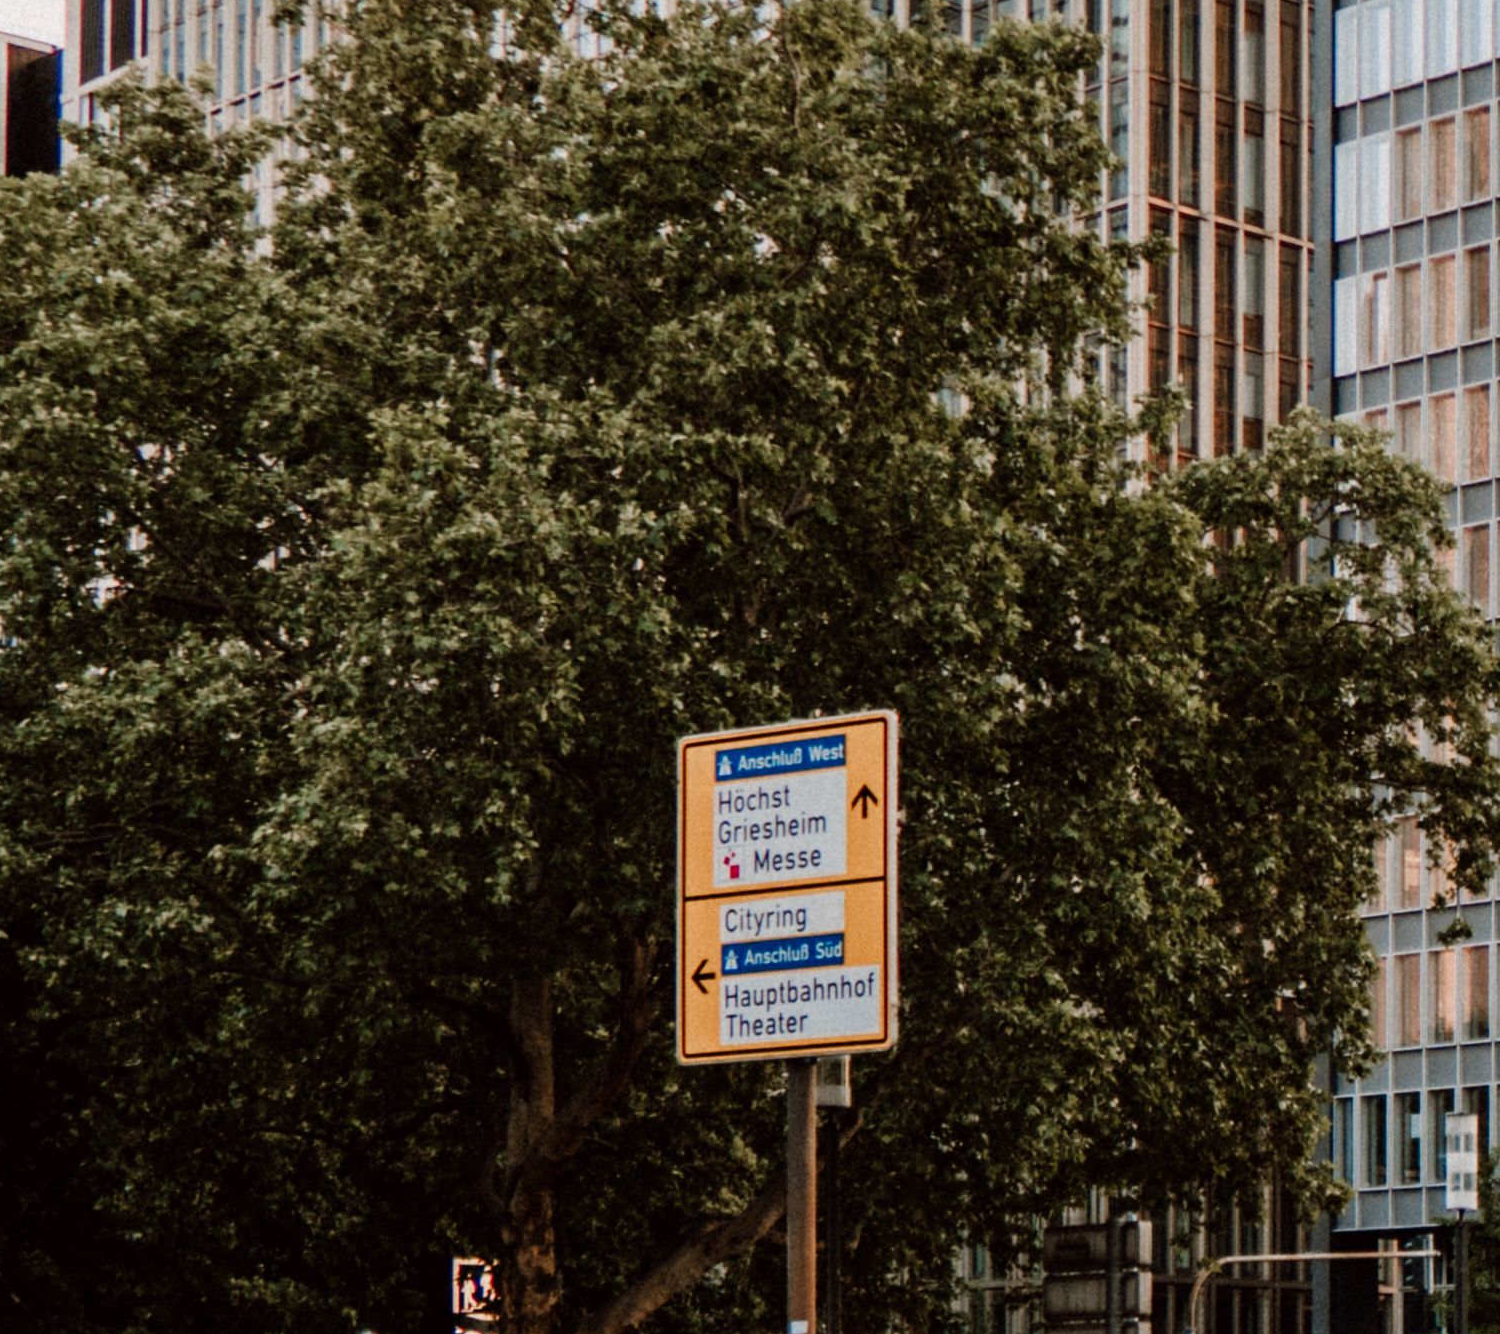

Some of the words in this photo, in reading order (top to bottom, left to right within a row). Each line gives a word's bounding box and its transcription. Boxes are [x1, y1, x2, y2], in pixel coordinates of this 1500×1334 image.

[738, 747, 802, 771] Anschluß
[809, 743, 844, 762] West
[718, 785, 790, 814] Höchst
[719, 811, 826, 844] Griesheim
[754, 848, 821, 873] Messe
[725, 904, 806, 936] Cityring
[744, 944, 809, 966] Anschluß
[815, 941, 843, 959] Süd
[725, 972, 874, 1011] Hauptbahnhof
[725, 1012, 808, 1038] Theater
